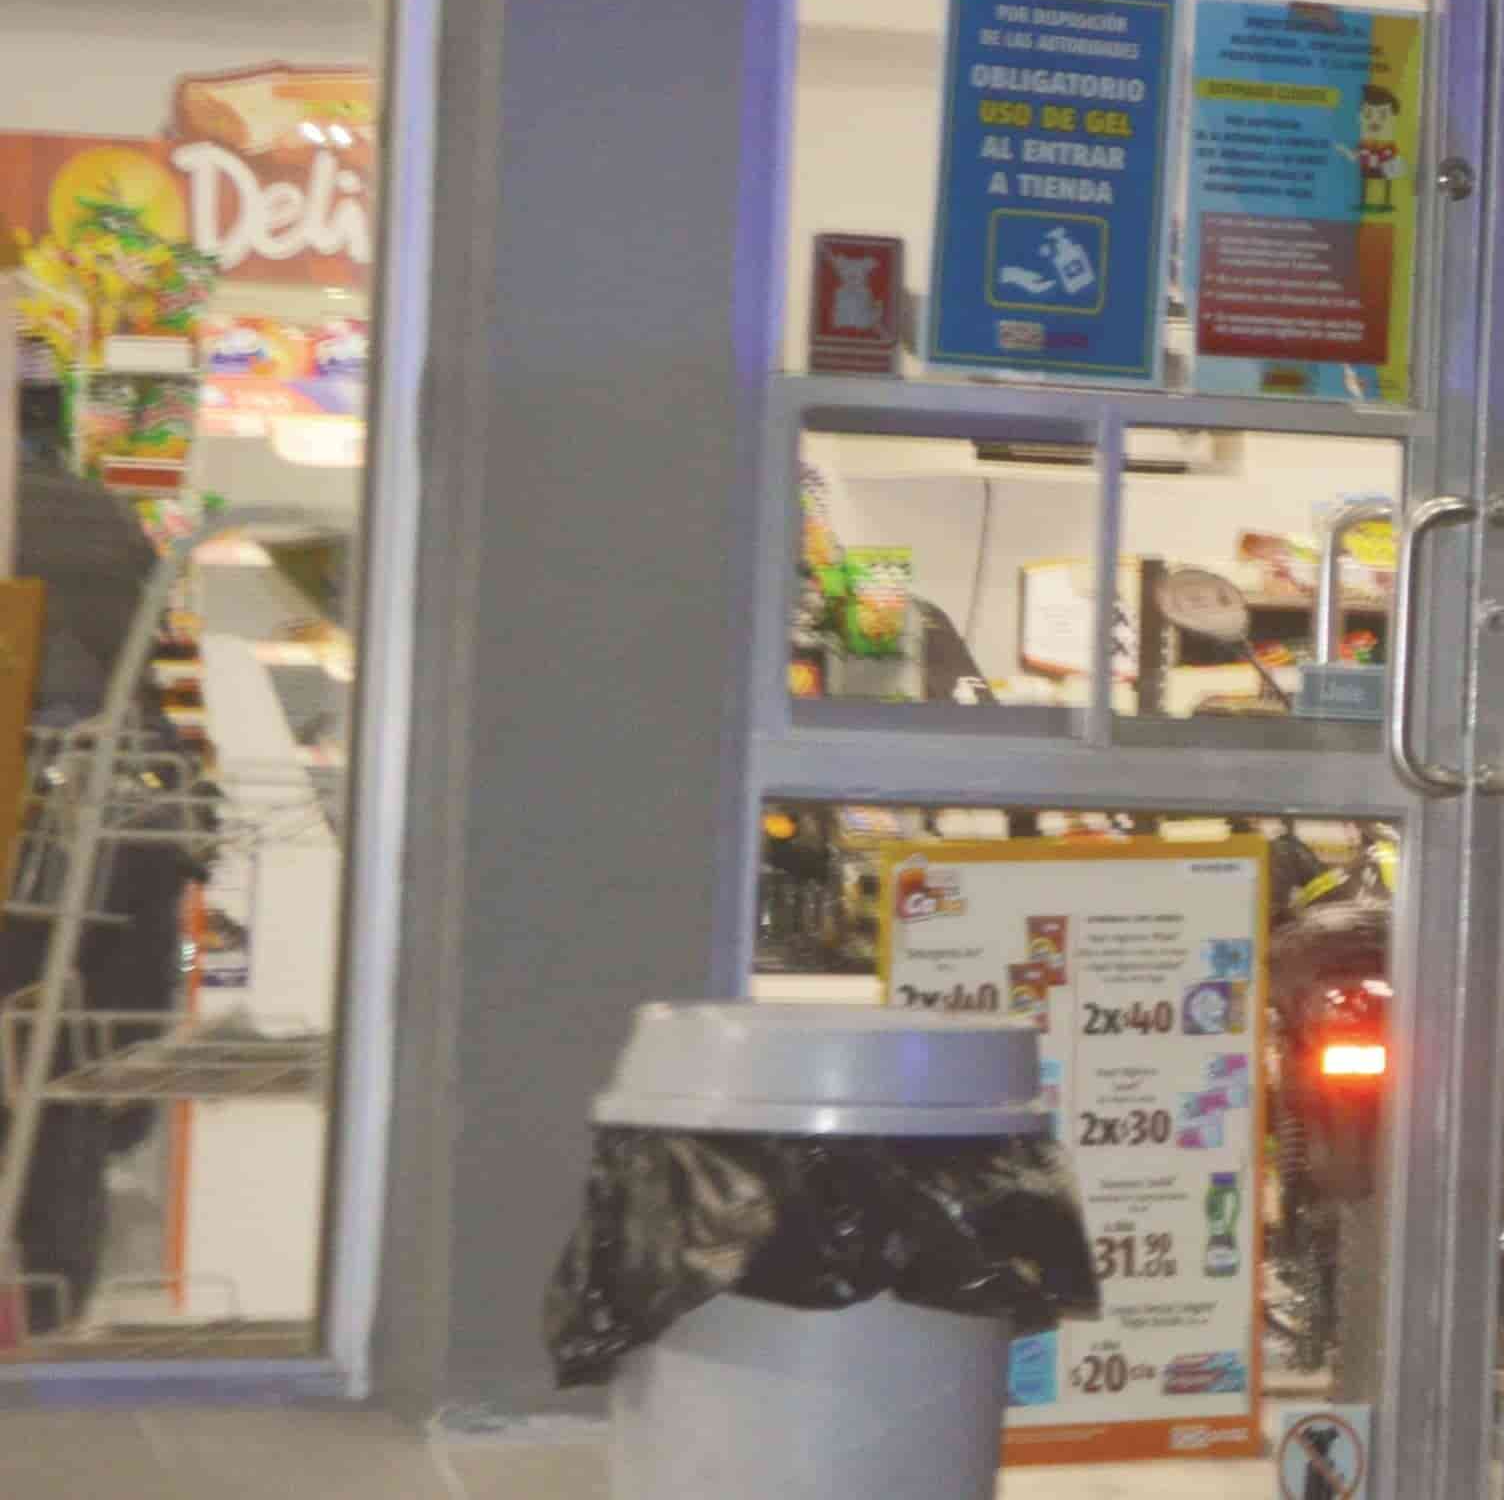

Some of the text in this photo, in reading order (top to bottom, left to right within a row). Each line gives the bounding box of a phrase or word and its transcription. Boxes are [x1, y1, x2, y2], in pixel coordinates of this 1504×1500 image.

[969, 63, 1147, 104] OBLIGATORIO
[979, 100, 1133, 137] USO DE GEL
[981, 134, 1127, 171] AL ENTRAR
[988, 171, 1115, 204] A TIENDA
